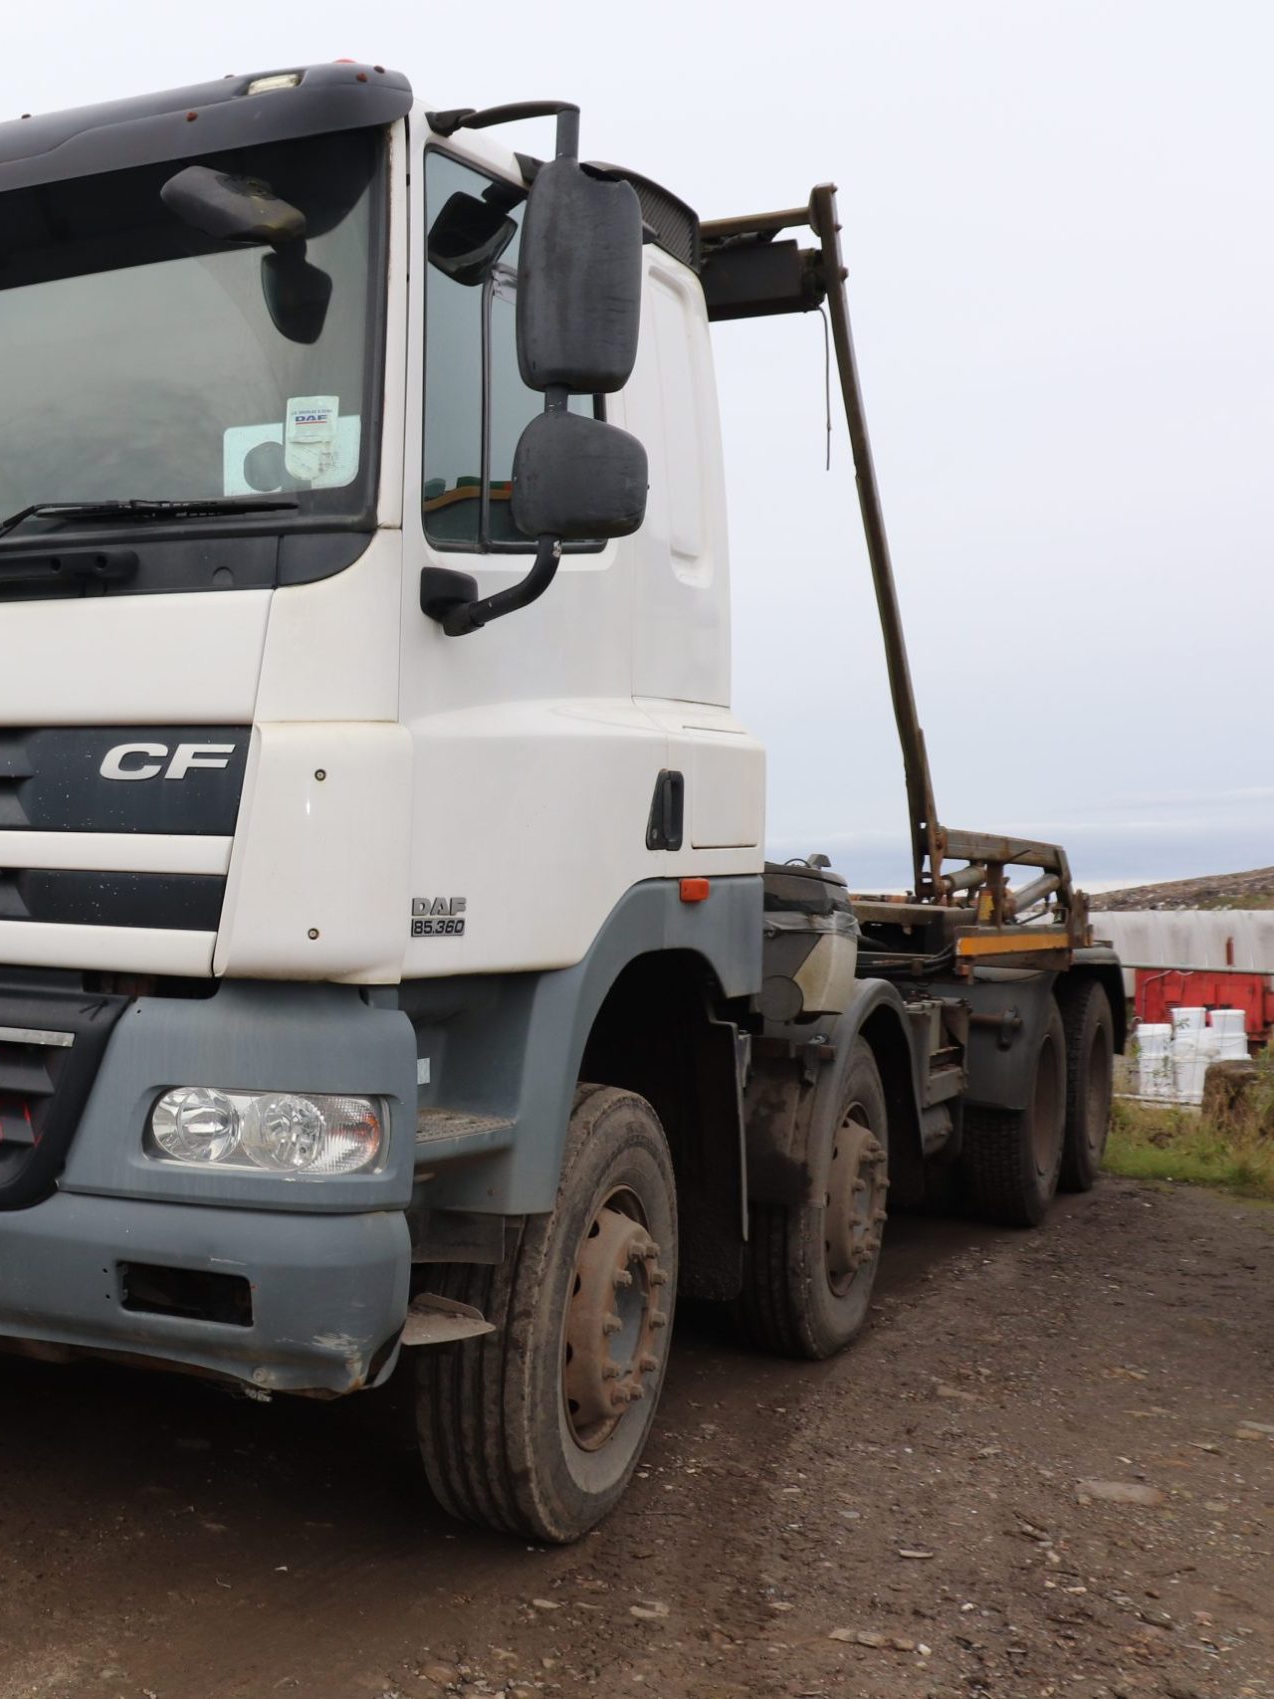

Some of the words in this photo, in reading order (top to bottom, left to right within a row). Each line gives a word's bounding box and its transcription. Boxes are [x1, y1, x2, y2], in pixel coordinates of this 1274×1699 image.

[294, 414, 328, 422] DAF
[99, 742, 236, 780] CF
[411, 897, 467, 916] DAF
[413, 920, 465, 935] 85.360
